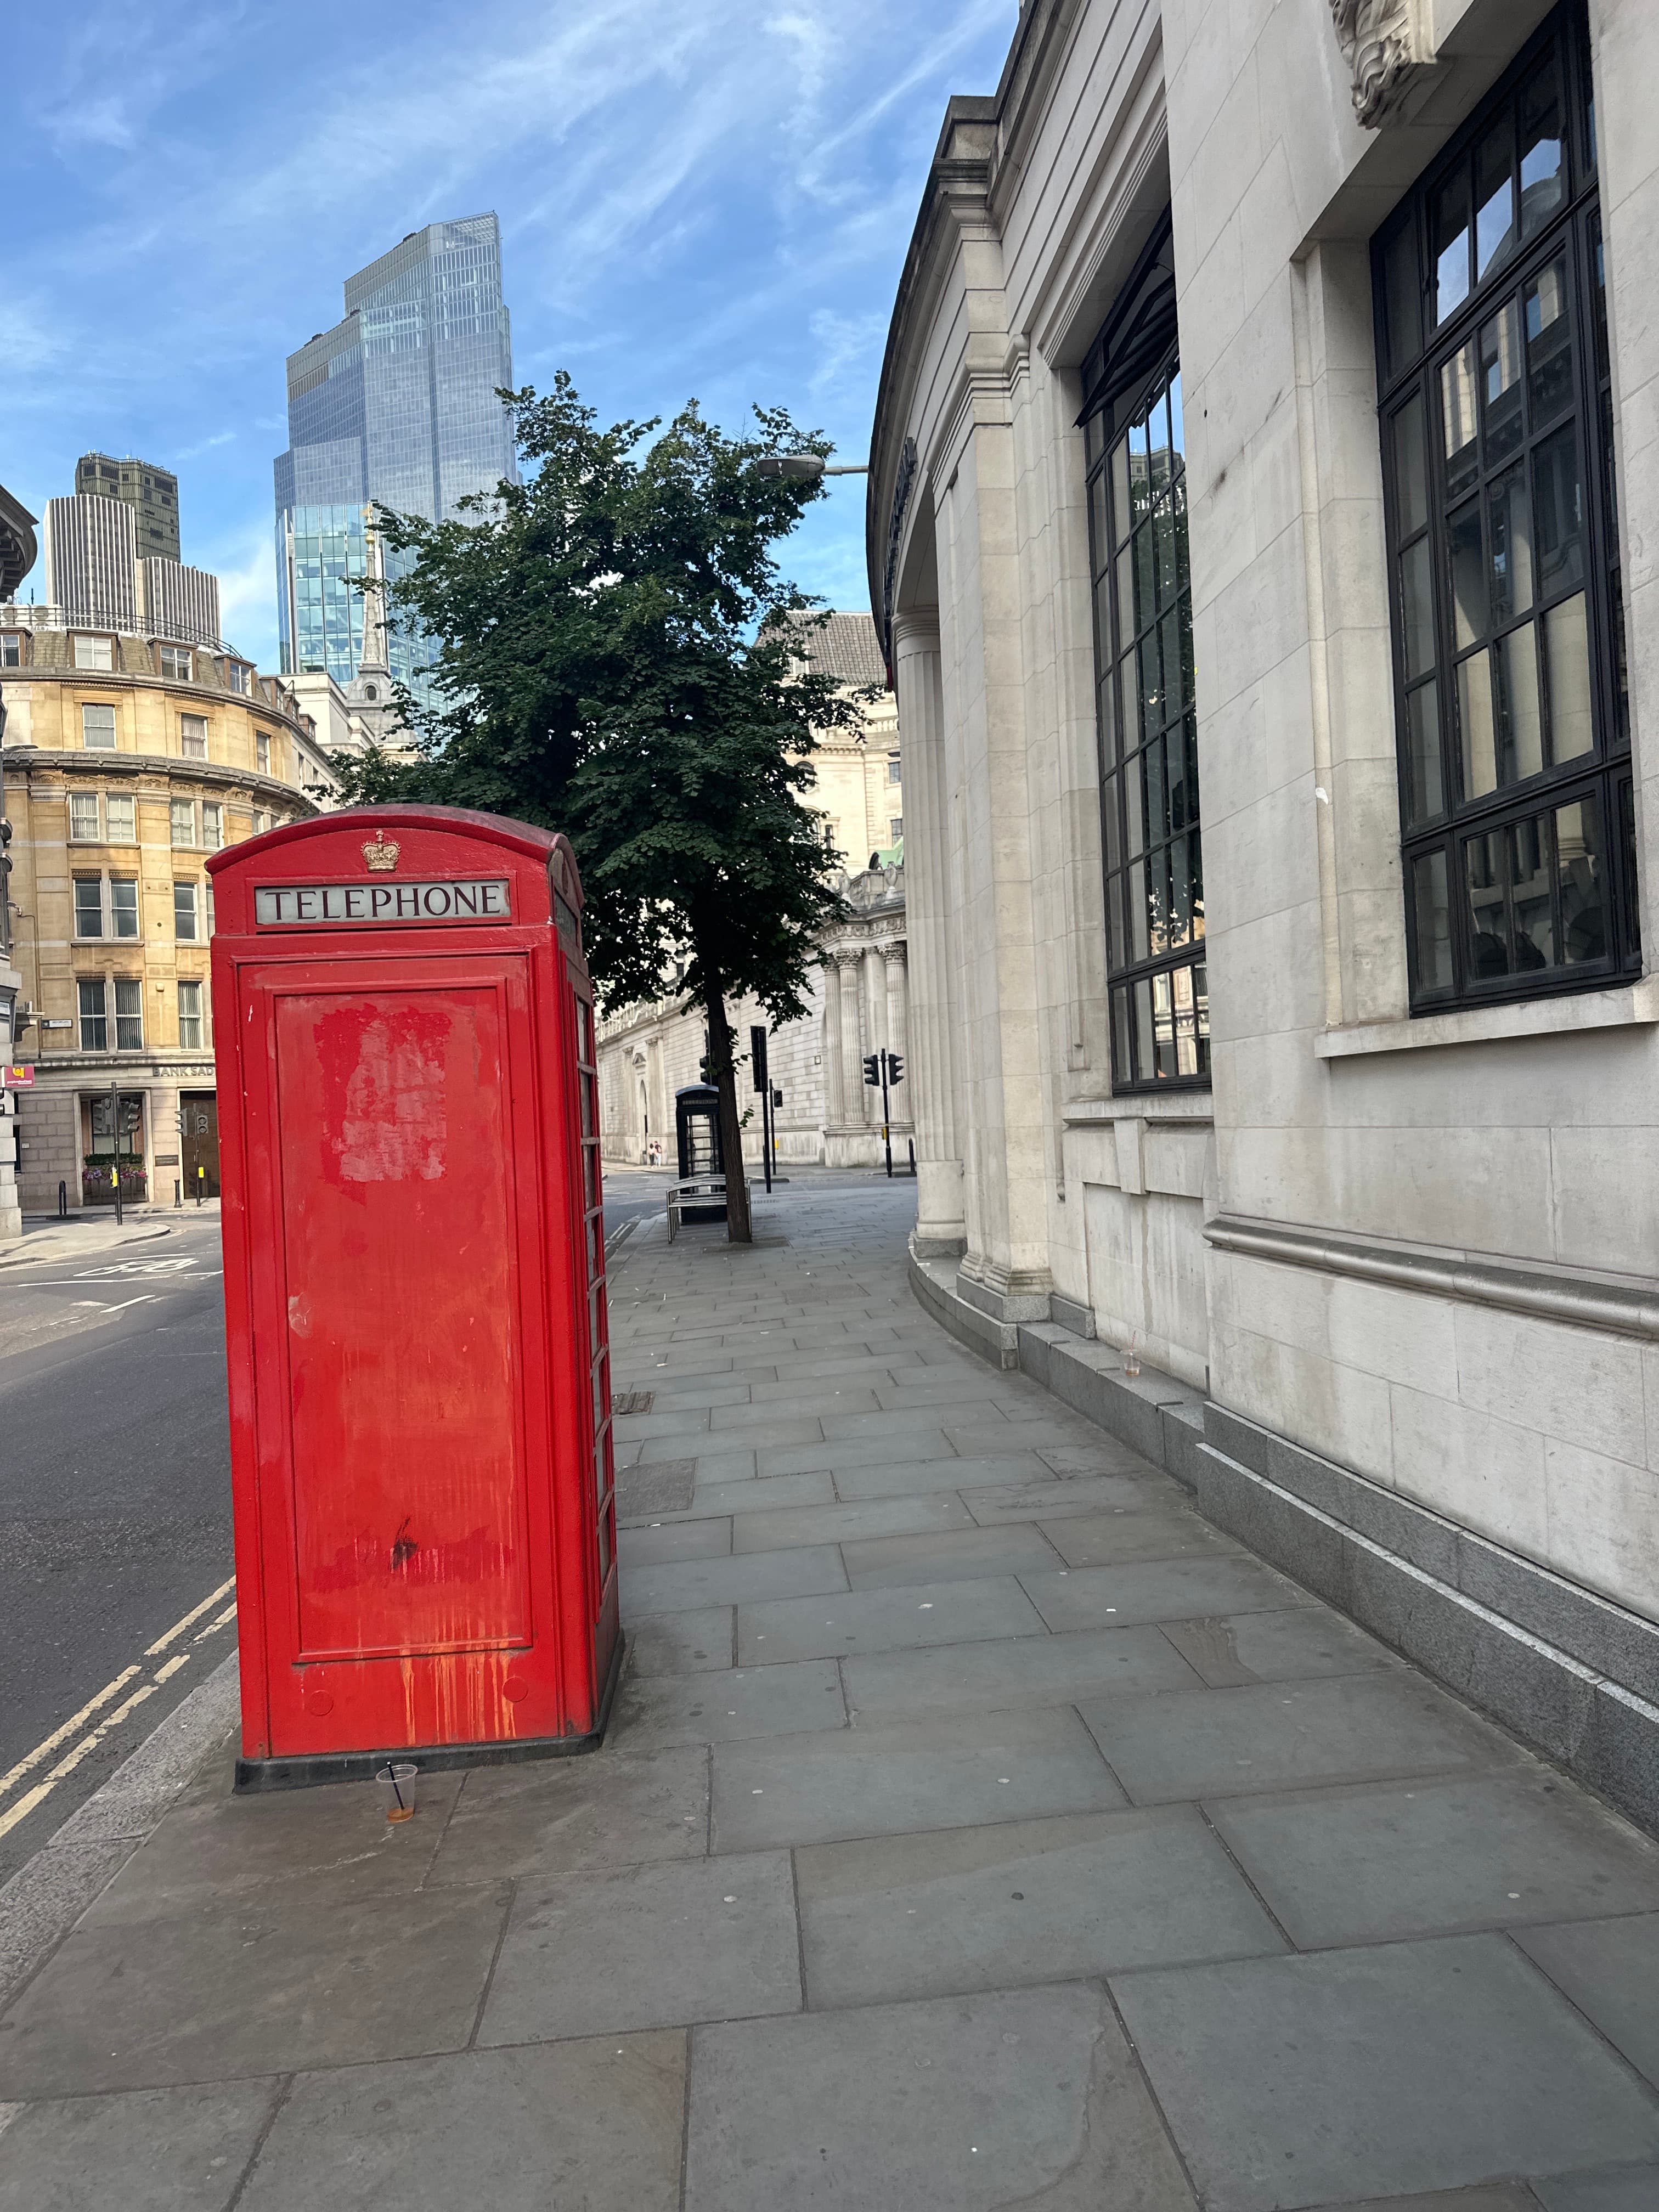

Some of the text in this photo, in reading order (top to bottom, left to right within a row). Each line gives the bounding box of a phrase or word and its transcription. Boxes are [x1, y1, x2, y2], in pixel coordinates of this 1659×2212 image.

[265, 885, 500, 921] TELEPHONE
[153, 1066, 214, 1076] BANK SAD
